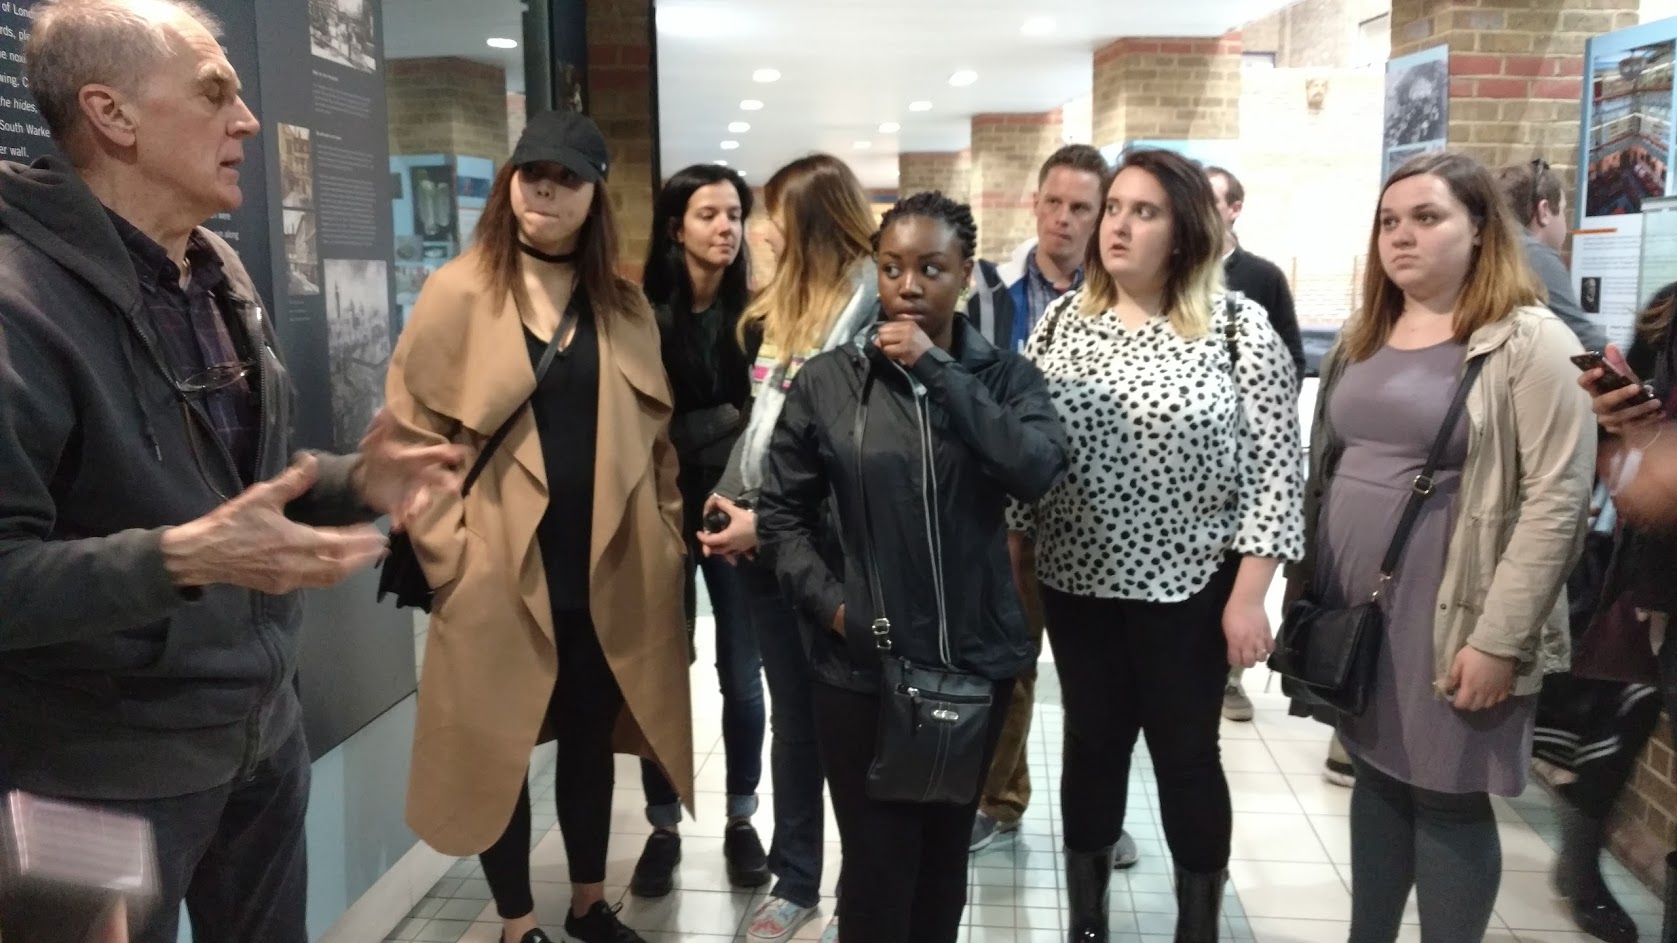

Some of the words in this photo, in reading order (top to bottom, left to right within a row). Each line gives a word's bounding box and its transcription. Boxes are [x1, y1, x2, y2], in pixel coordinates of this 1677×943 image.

[1, 1, 12, 12] of
[13, 98, 38, 114] hides,
[0, 119, 24, 133] South
[9, 146, 29, 158] wall.
